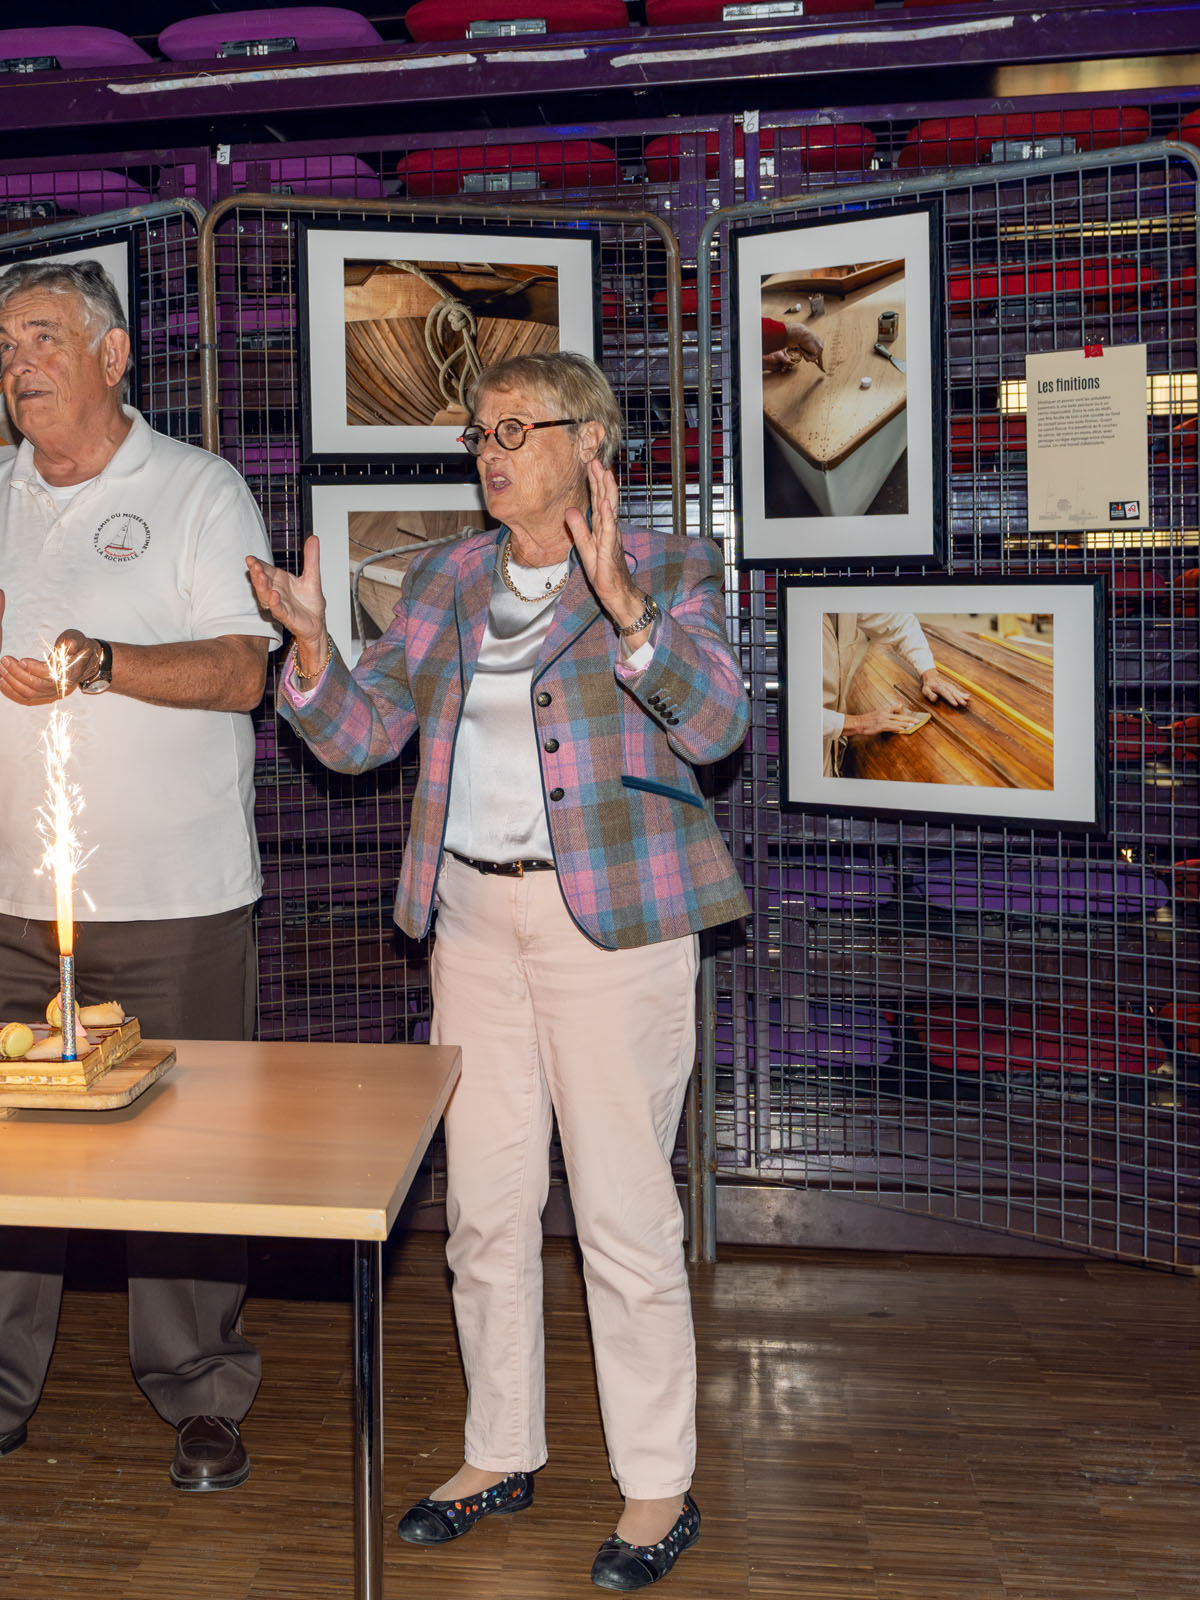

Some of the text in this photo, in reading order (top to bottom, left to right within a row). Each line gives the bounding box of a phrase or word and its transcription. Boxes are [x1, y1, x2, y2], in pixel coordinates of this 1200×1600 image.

[746, 115, 755, 131] 6
[218, 151, 227, 163] 5
[1037, 376, 1100, 393] Les finitions
[98, 519, 110, 532] AMIS
[142, 522, 150, 549] MARITIME
[104, 553, 138, 562] ROCHELLE
